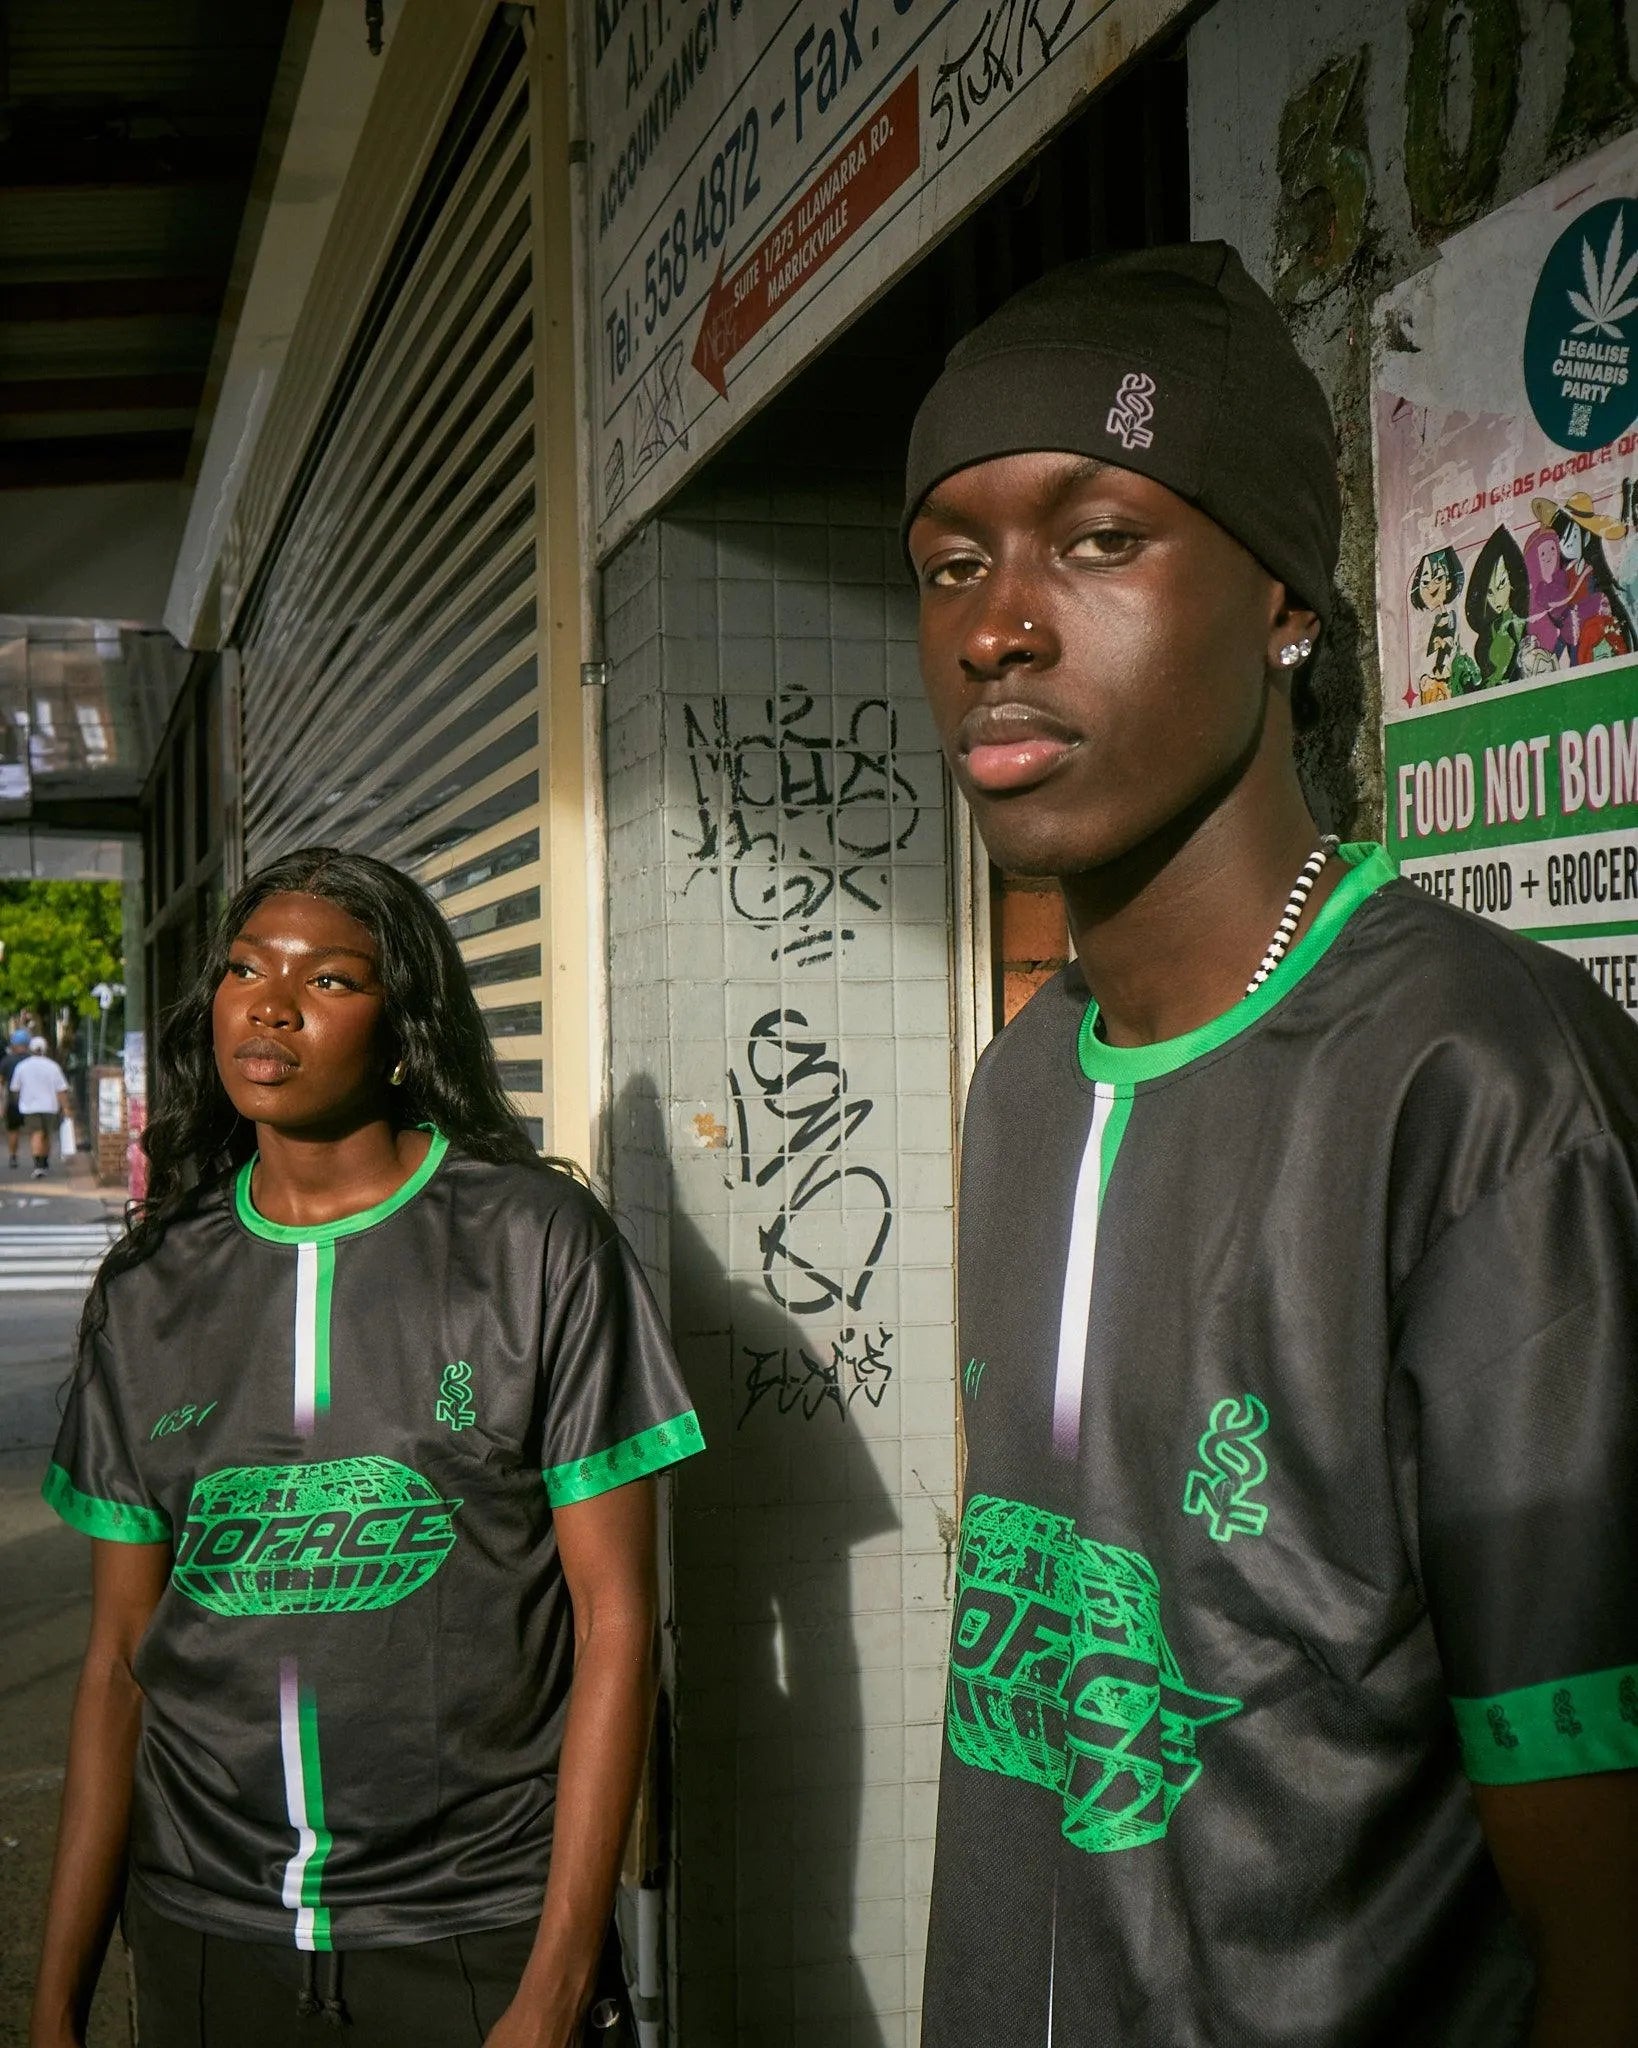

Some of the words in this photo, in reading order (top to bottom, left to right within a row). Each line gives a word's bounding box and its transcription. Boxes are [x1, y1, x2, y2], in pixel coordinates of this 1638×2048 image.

[734, 259, 760, 308] SUITE
[764, 220, 794, 273] 1/275
[797, 140, 867, 237] ILLAWARRA
[870, 114, 895, 161] RD.
[767, 198, 848, 308] MARRICKVILLE
[606, 288, 640, 386] Tel:
[1552, 358, 1629, 386] CANNABIS
[1559, 339, 1630, 365] LEGALISE
[1561, 380, 1612, 404] PARTY
[1397, 753, 1475, 839] FOOD
[1485, 735, 1550, 827] NOT
[1462, 862, 1512, 914] FOOD
